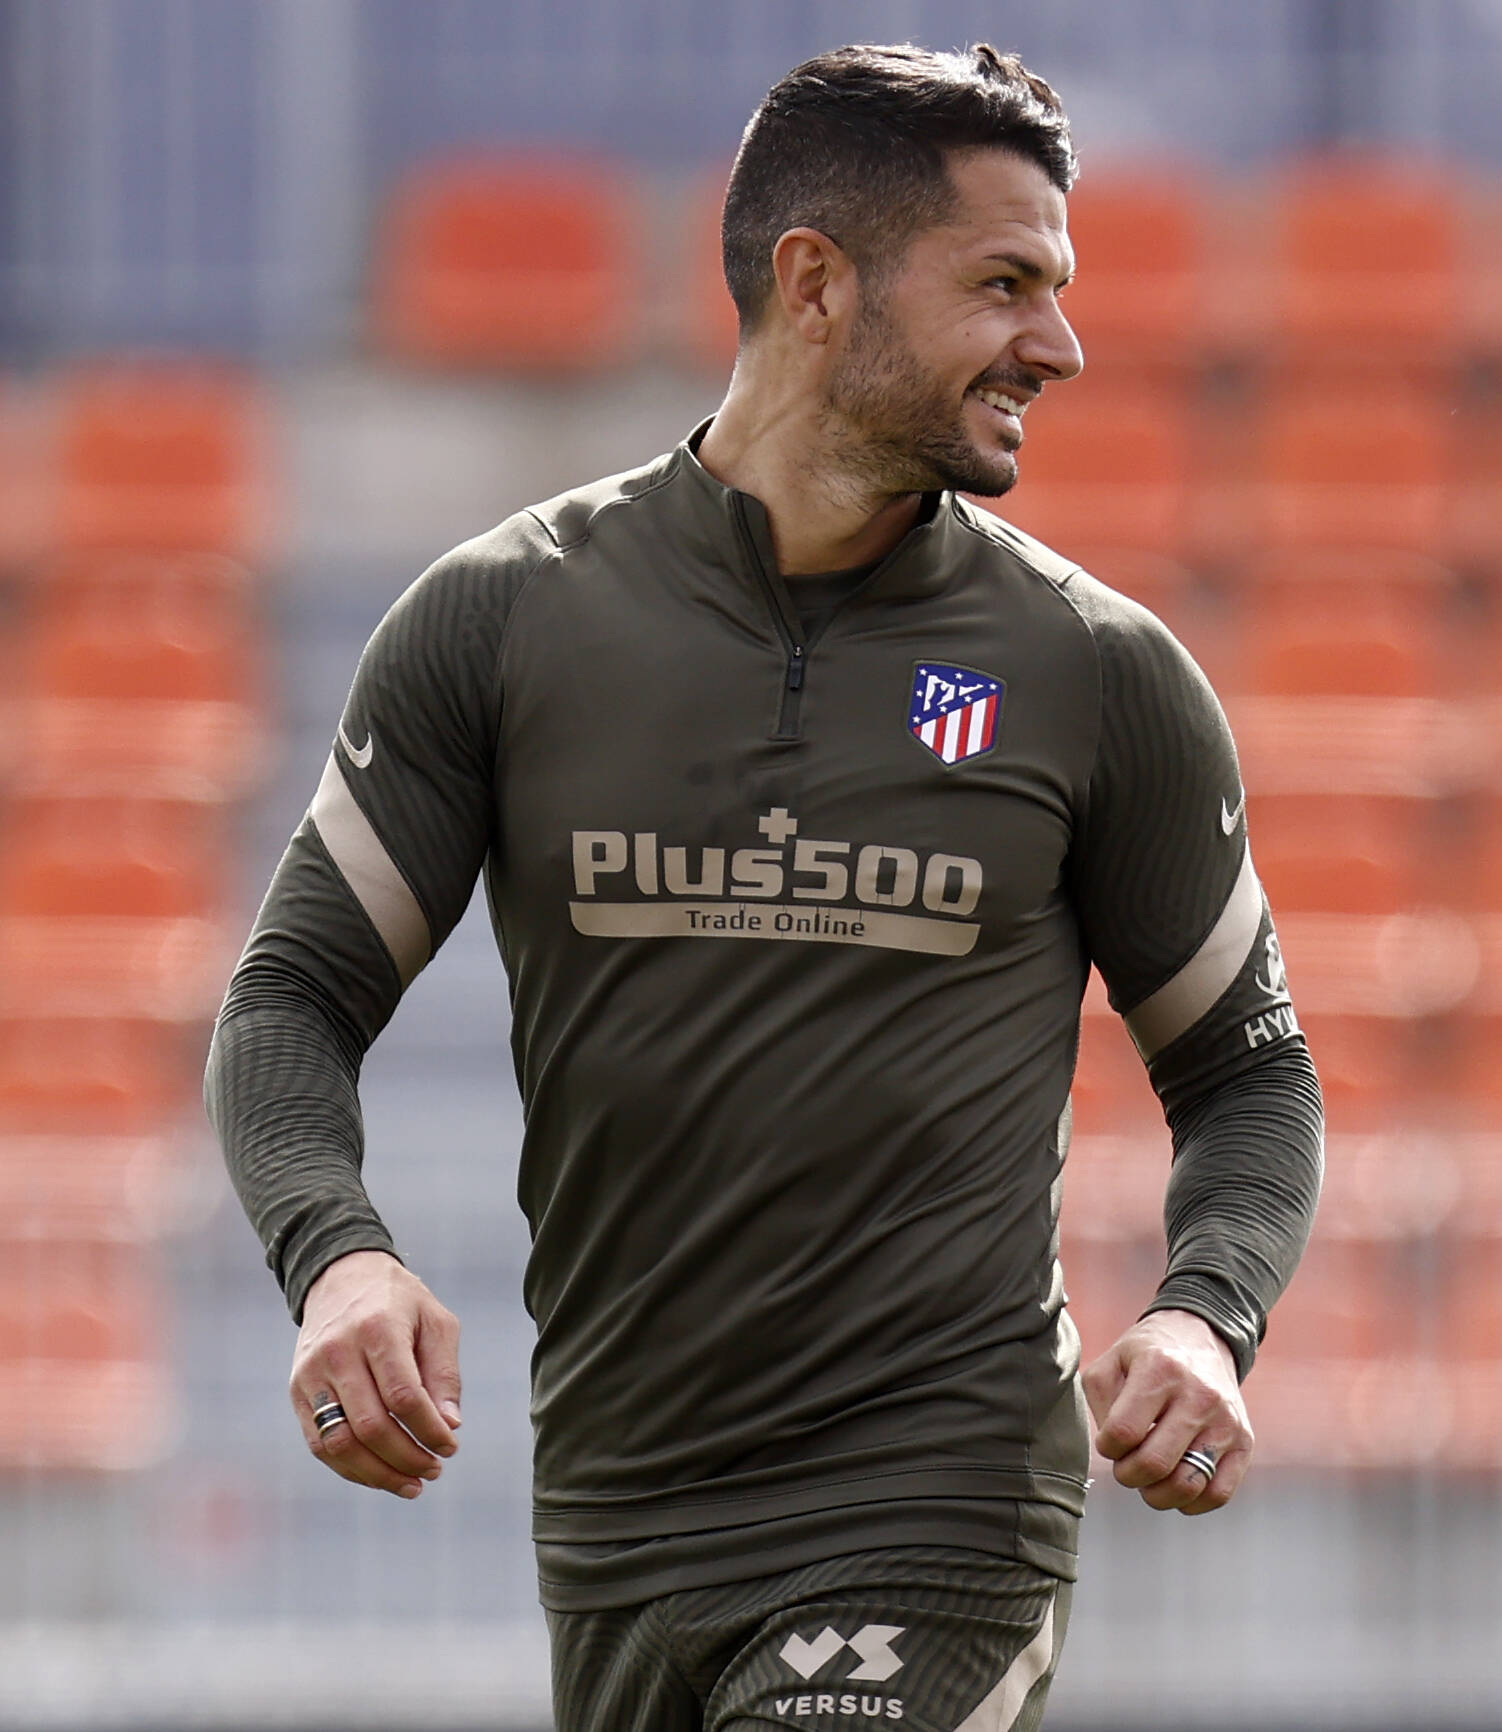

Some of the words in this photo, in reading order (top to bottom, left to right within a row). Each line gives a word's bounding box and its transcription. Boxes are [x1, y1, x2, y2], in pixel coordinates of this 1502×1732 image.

[572, 830, 984, 916] Plus500
[685, 910, 761, 931] Trade
[774, 912, 865, 937] Online
[775, 1694, 904, 1720] VERSUS
